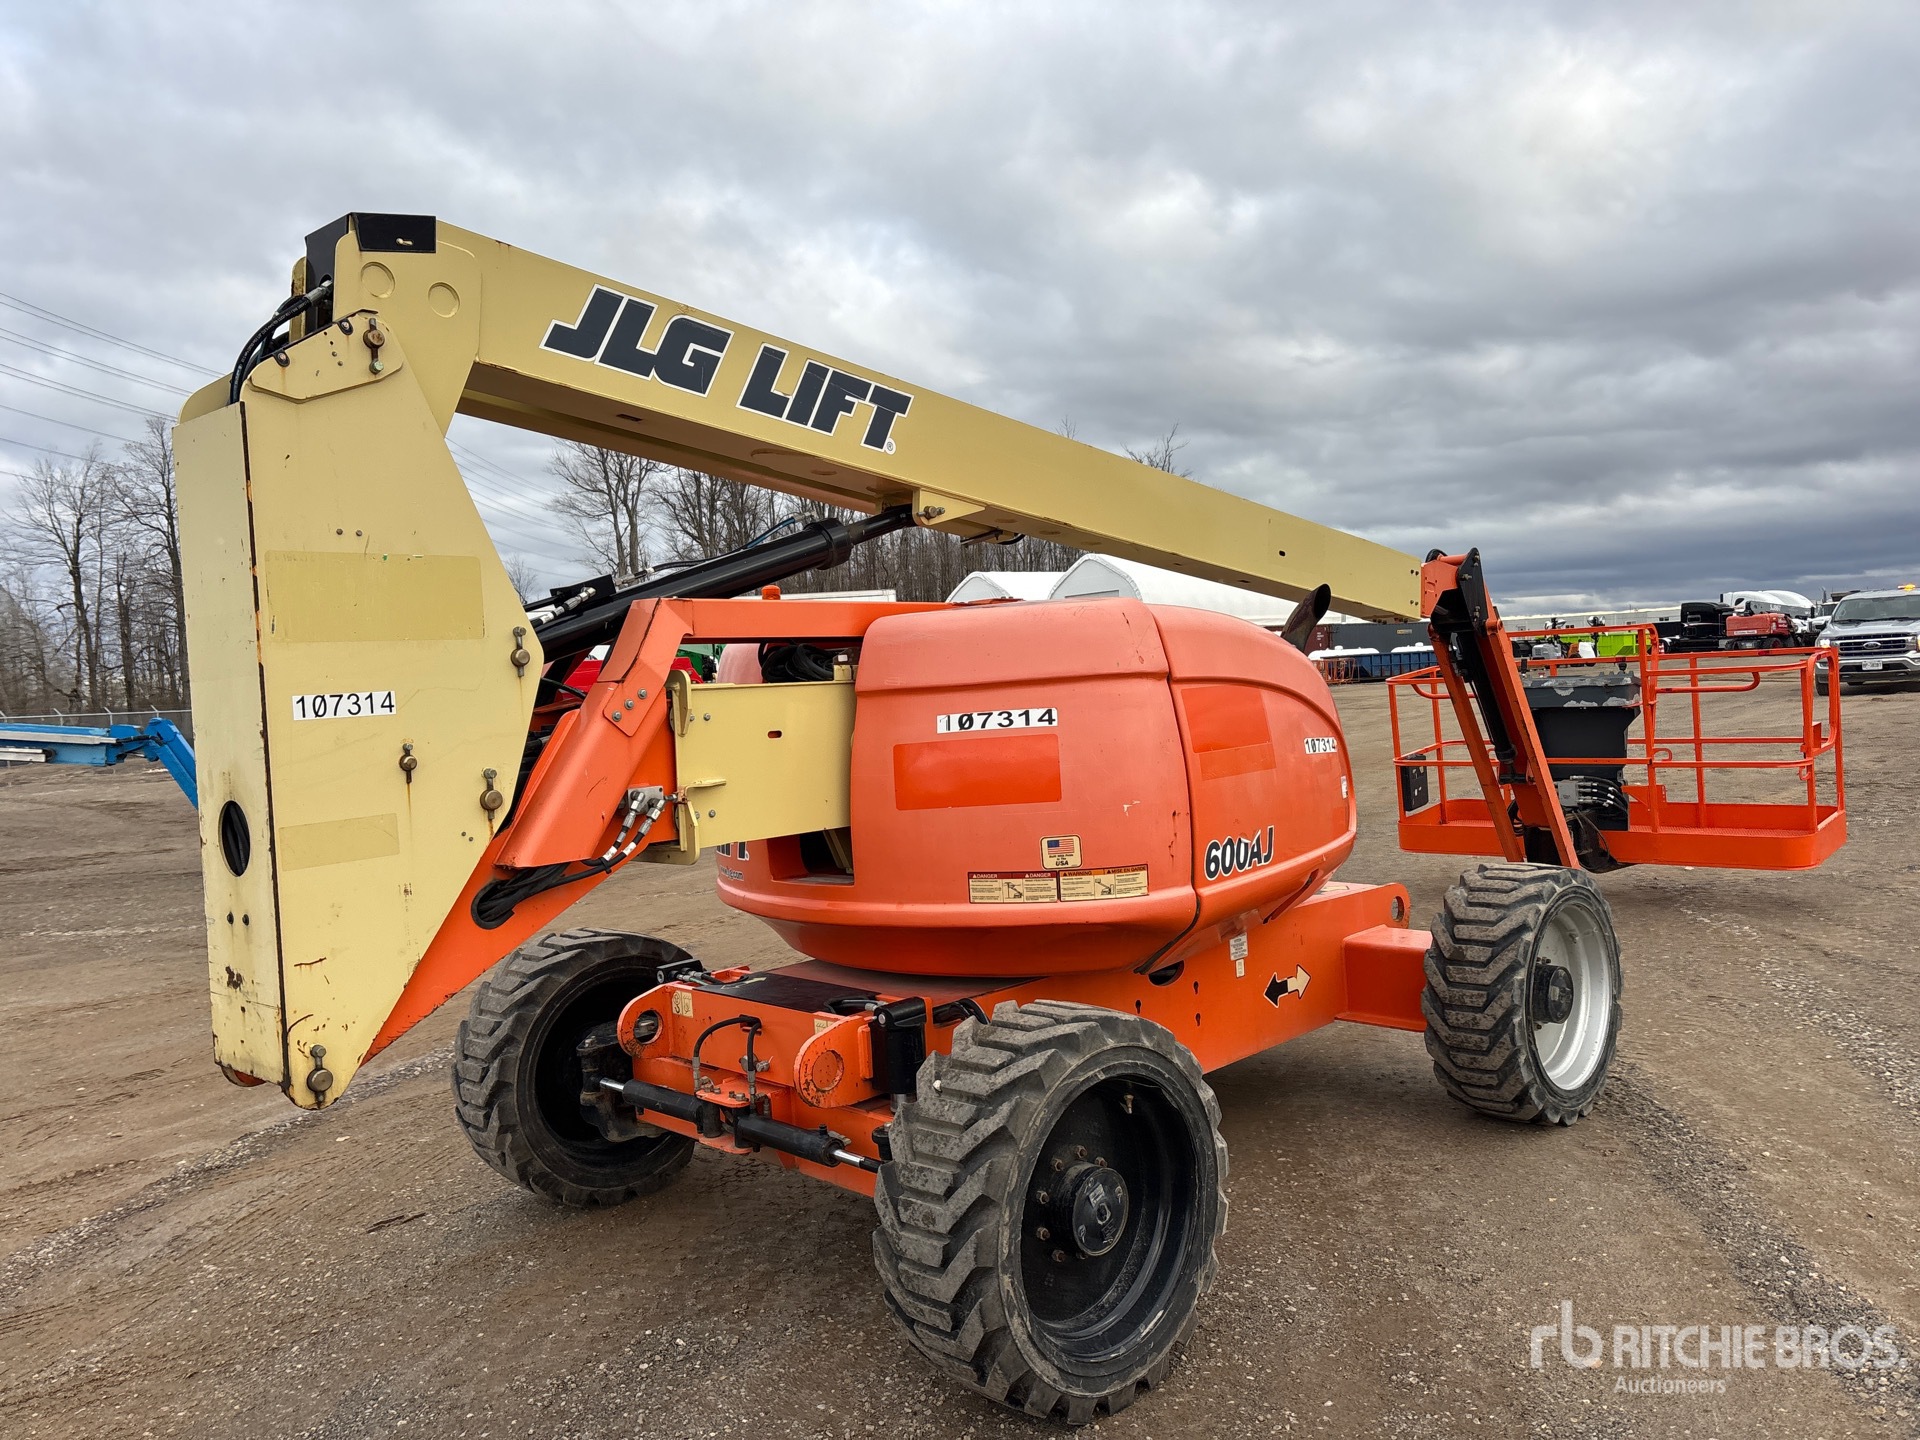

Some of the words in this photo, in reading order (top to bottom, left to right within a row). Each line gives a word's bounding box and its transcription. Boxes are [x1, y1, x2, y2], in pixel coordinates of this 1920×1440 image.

[539, 283, 735, 398] JLG
[737, 342, 914, 451] LIFT
[296, 691, 395, 719] 107314
[939, 708, 1056, 732] 107314
